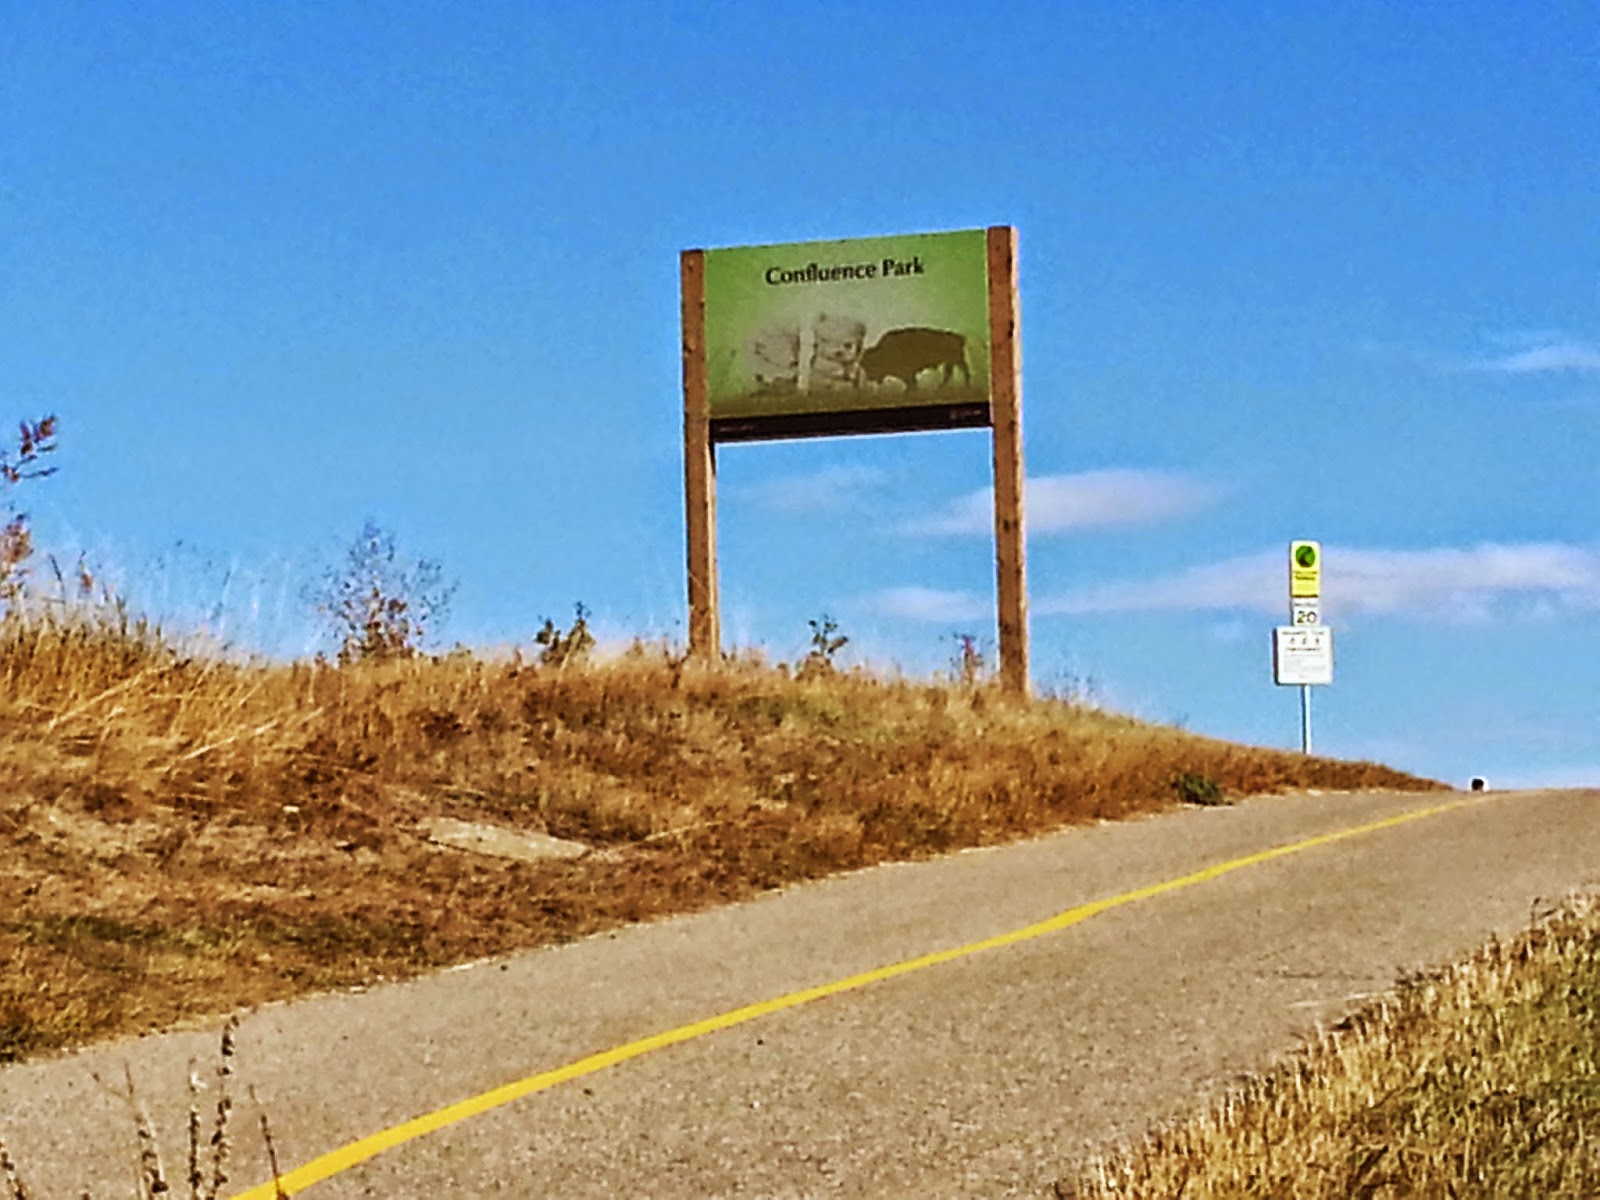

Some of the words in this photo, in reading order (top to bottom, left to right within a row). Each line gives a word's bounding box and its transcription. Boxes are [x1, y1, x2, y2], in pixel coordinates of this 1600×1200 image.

[765, 263, 877, 286] Confluence
[882, 256, 925, 277] Park
[1296, 610, 1317, 624] 20
